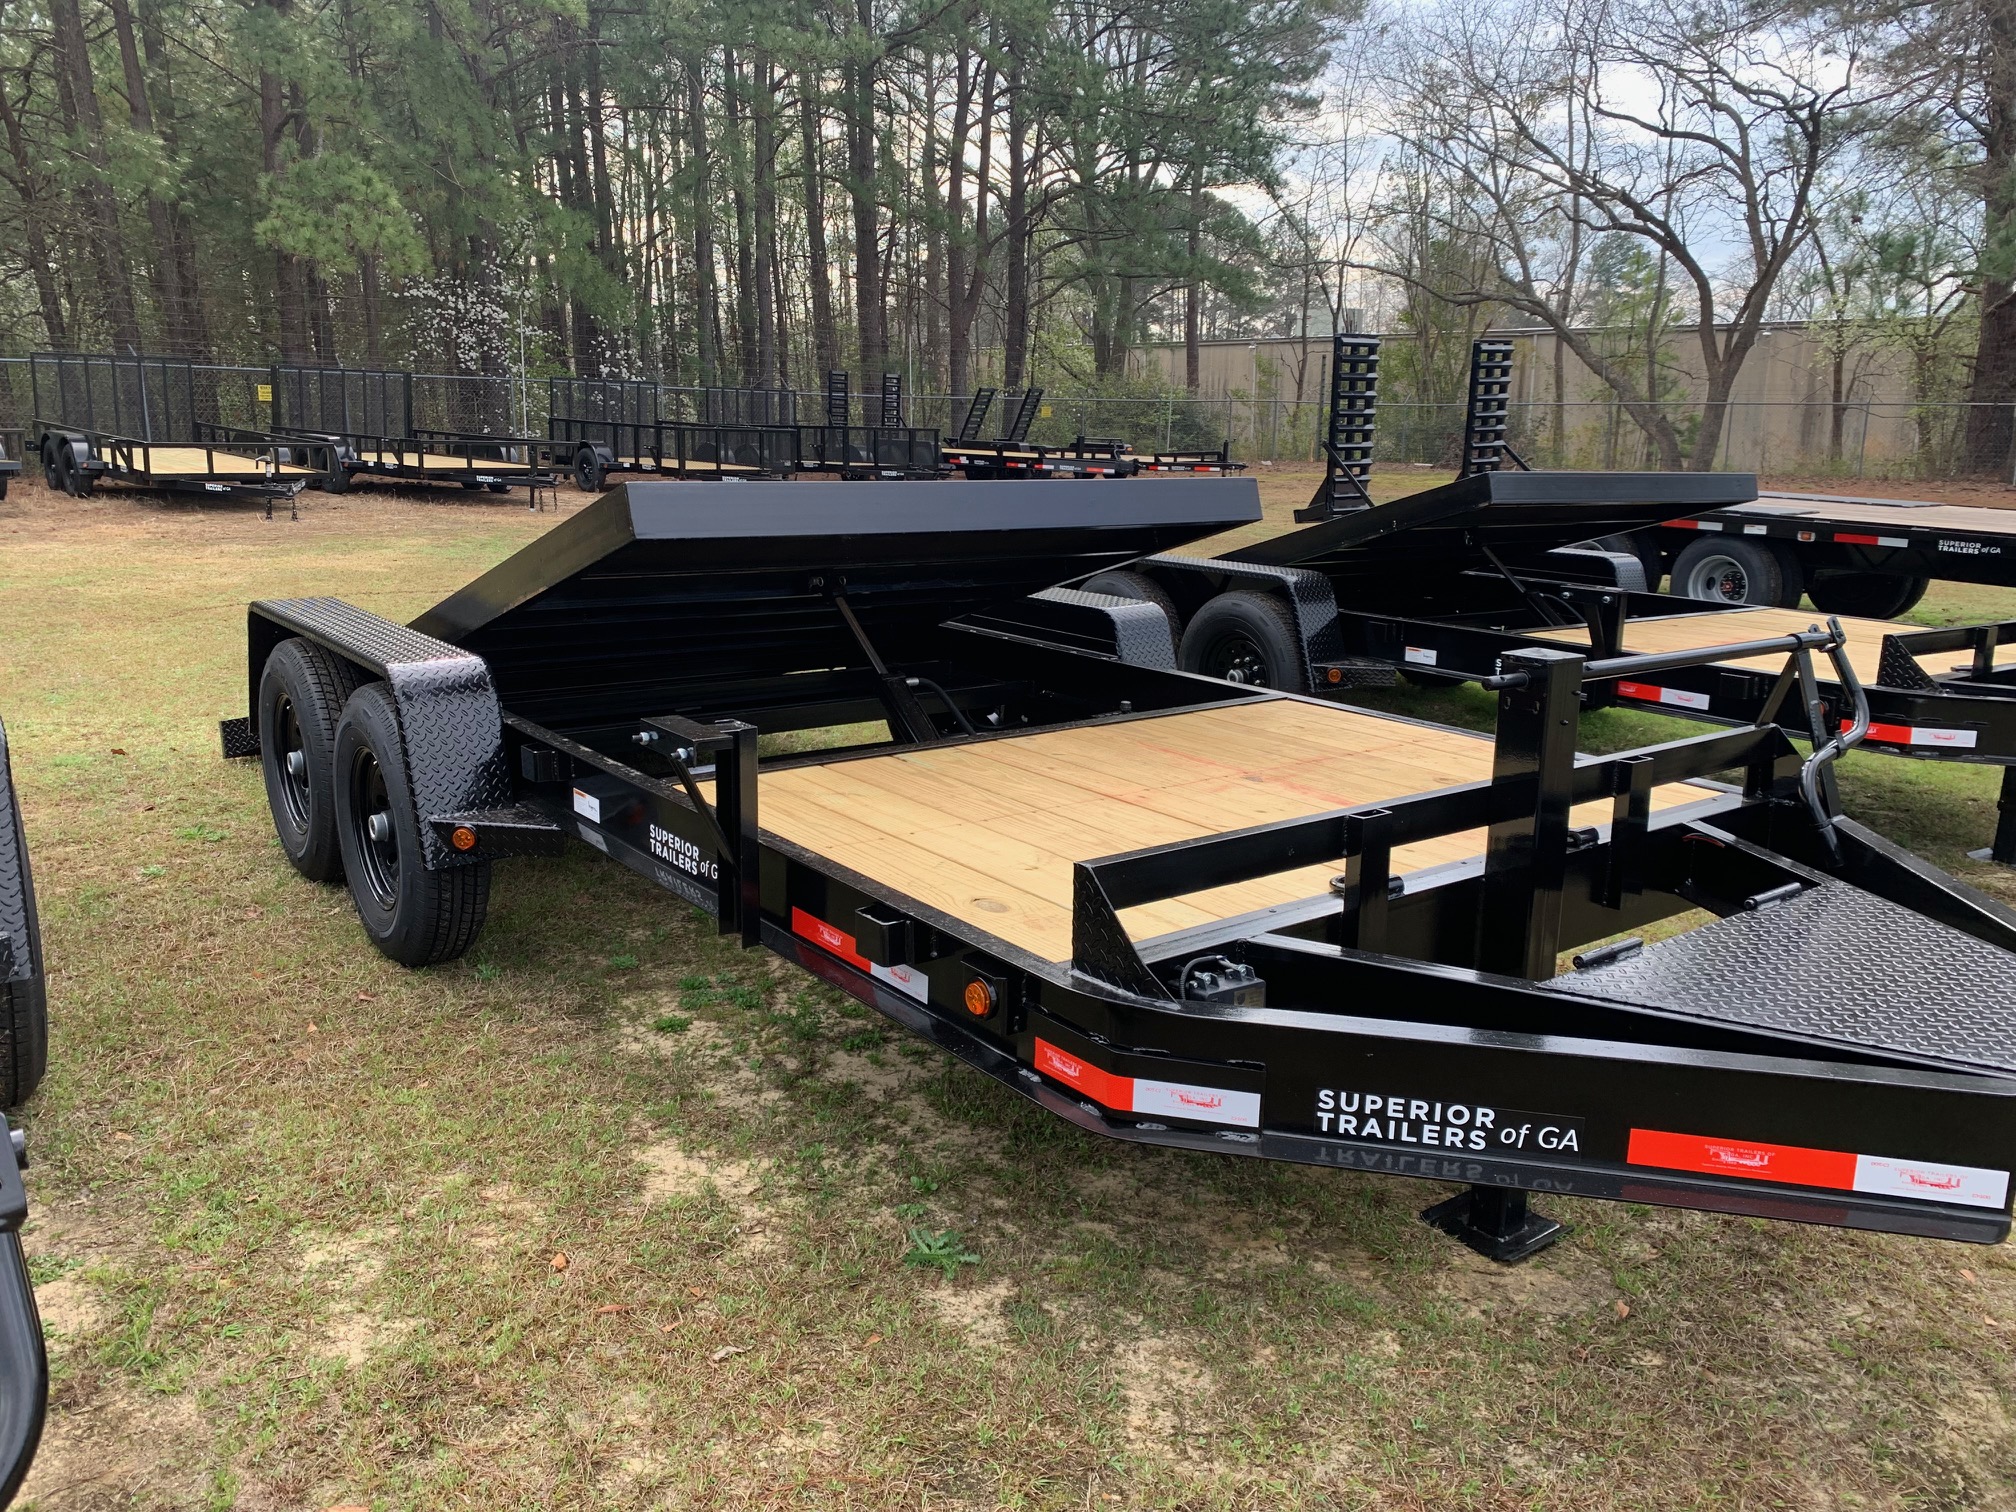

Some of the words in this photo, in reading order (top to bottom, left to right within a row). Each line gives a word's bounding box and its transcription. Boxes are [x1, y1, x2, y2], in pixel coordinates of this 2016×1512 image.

[1938, 539, 1982, 549] SUPERIOR
[1938, 545, 1979, 554] TRAILERS
[649, 824, 700, 861] SUPERIOR
[649, 838, 698, 876] TRAILERS
[700, 860, 710, 878] of
[711, 863, 718, 880] G
[1317, 1089, 1496, 1129] SUPERIOR
[1316, 1111, 1487, 1151] TRAILERS
[1500, 1123, 1532, 1149] of
[1537, 1126, 1580, 1152] GA
[1737, 1148, 1766, 1156] TRAILERS
